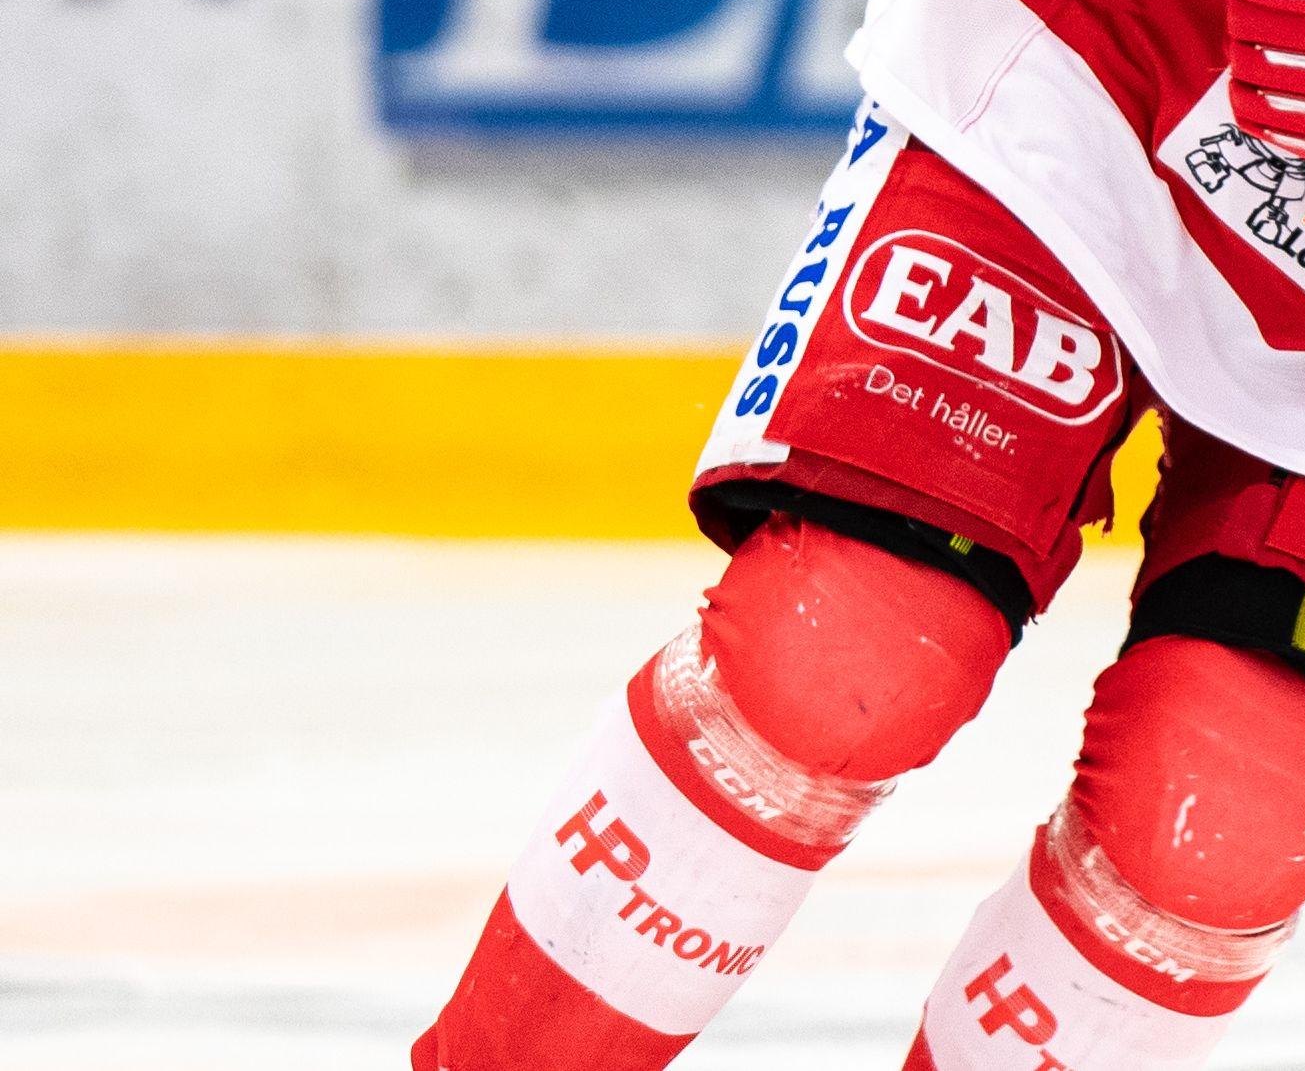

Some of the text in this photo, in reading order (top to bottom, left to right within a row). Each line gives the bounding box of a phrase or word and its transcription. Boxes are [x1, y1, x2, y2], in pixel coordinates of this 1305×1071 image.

[860, 244, 1102, 406] EAB
[865, 363, 1018, 455] Det håller.
[687, 738, 784, 821] CCM
[1094, 913, 1200, 984] CCM
